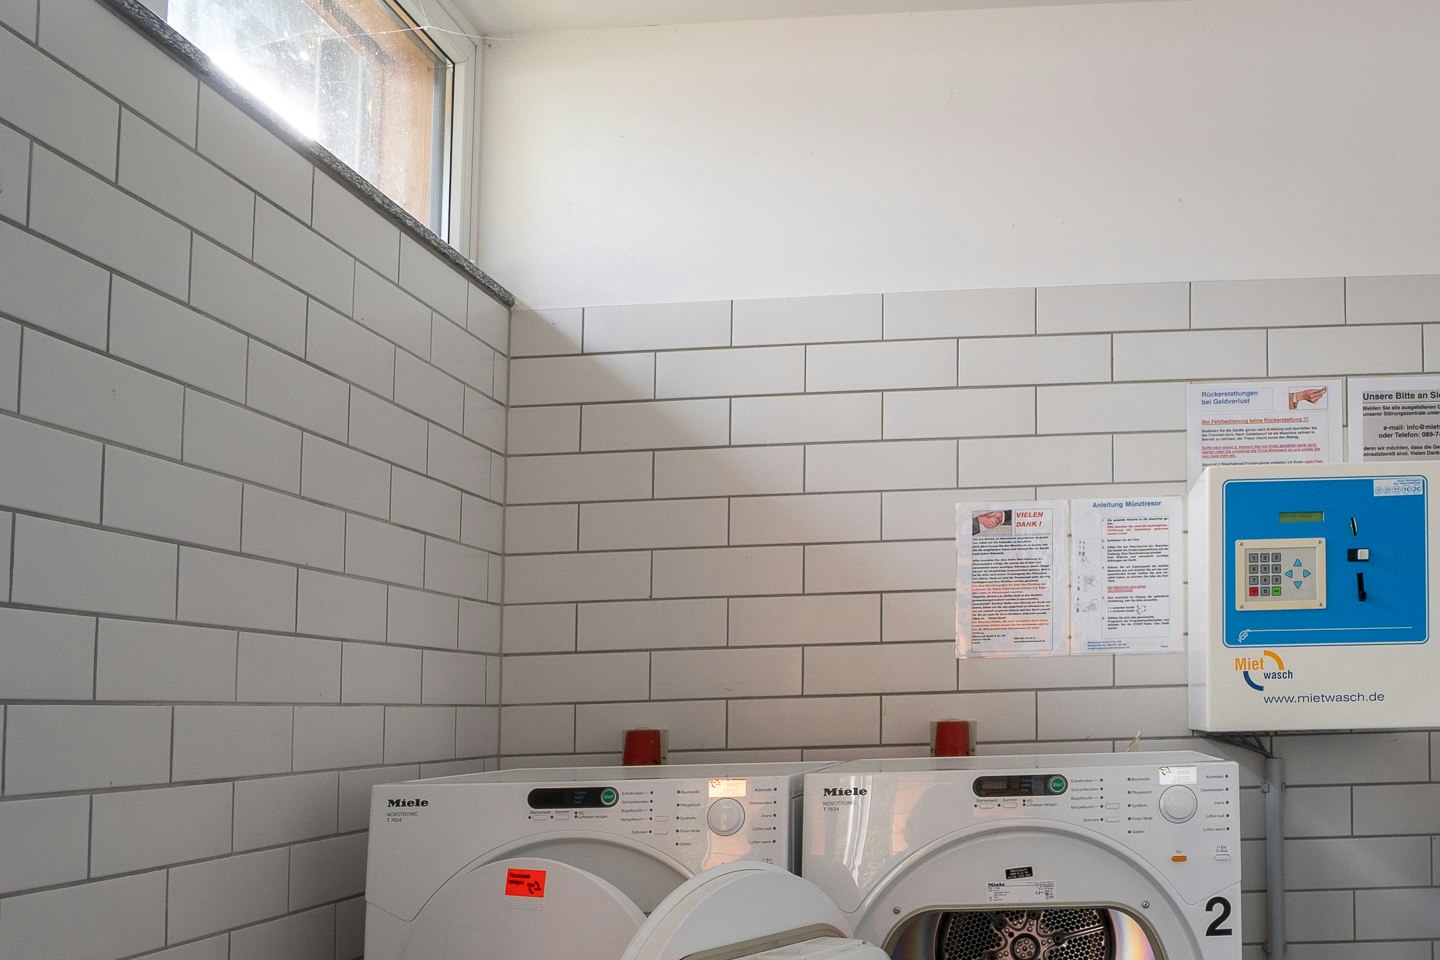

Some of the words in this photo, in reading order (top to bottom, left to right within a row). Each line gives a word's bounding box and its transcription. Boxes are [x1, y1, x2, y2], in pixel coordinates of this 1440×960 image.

[1201, 390, 1259, 398] Rückerstattungen
[1363, 393, 1394, 401] Unsere
[1395, 392, 1416, 400] Bitte
[1213, 397, 1250, 405] Geldverlust
[1234, 657, 1265, 671] Miet
[1263, 669, 1293, 680] wasch
[1263, 692, 1385, 704] www.mietwasch.de
[823, 787, 868, 797] Miele
[387, 798, 429, 808] Miele
[1205, 896, 1232, 937] 2
